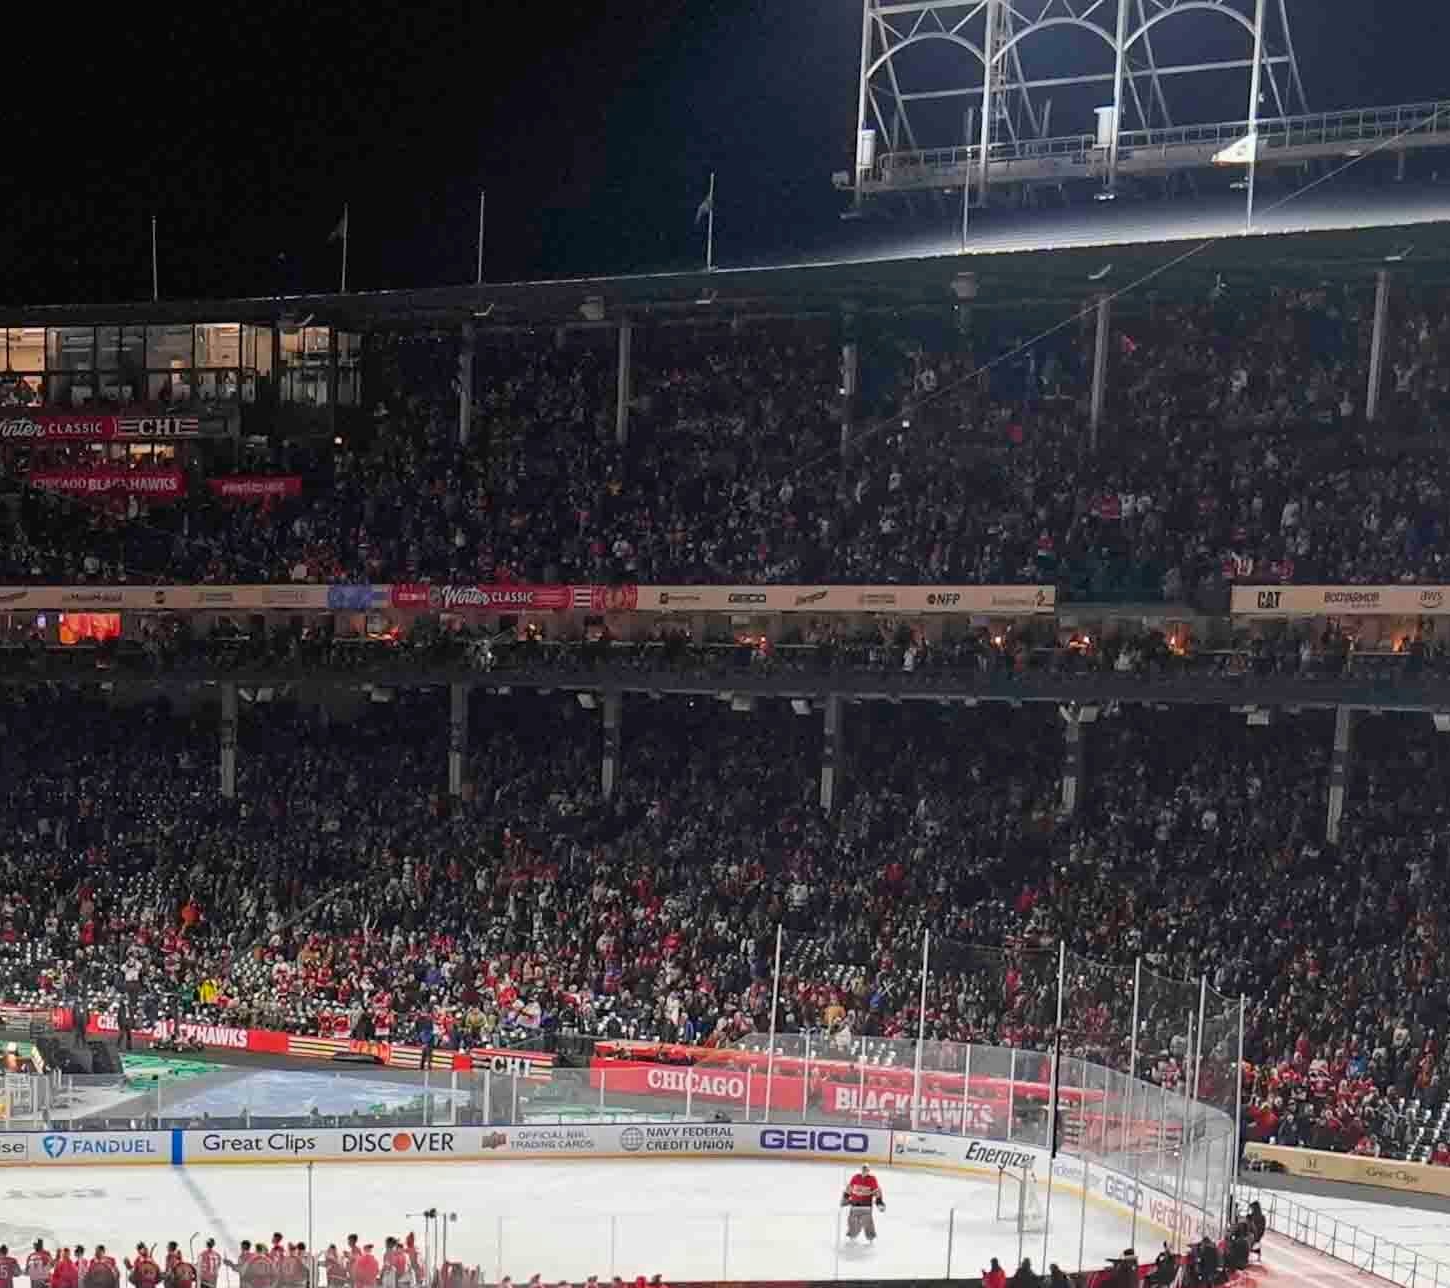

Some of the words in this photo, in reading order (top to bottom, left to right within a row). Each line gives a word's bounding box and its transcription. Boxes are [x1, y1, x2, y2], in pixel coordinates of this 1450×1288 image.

[49, 423, 103, 434] CLASSIC
[490, 592, 533, 603] CLASSIC
[1258, 591, 1282, 608] CAT
[647, 1070, 745, 1098] CHICAGO
[647, 1127, 680, 1138] NAVY
[683, 1127, 734, 1138] FEDERAL
[73, 1139, 157, 1154] FANDUEL
[203, 1133, 263, 1152] Great
[267, 1132, 316, 1155] Clips
[342, 1132, 454, 1153] DISCOVER
[647, 1140, 690, 1151] CREDIT
[693, 1140, 734, 1151] UNION
[759, 1129, 870, 1154] GEICO
[966, 1141, 1038, 1171] Energizer
